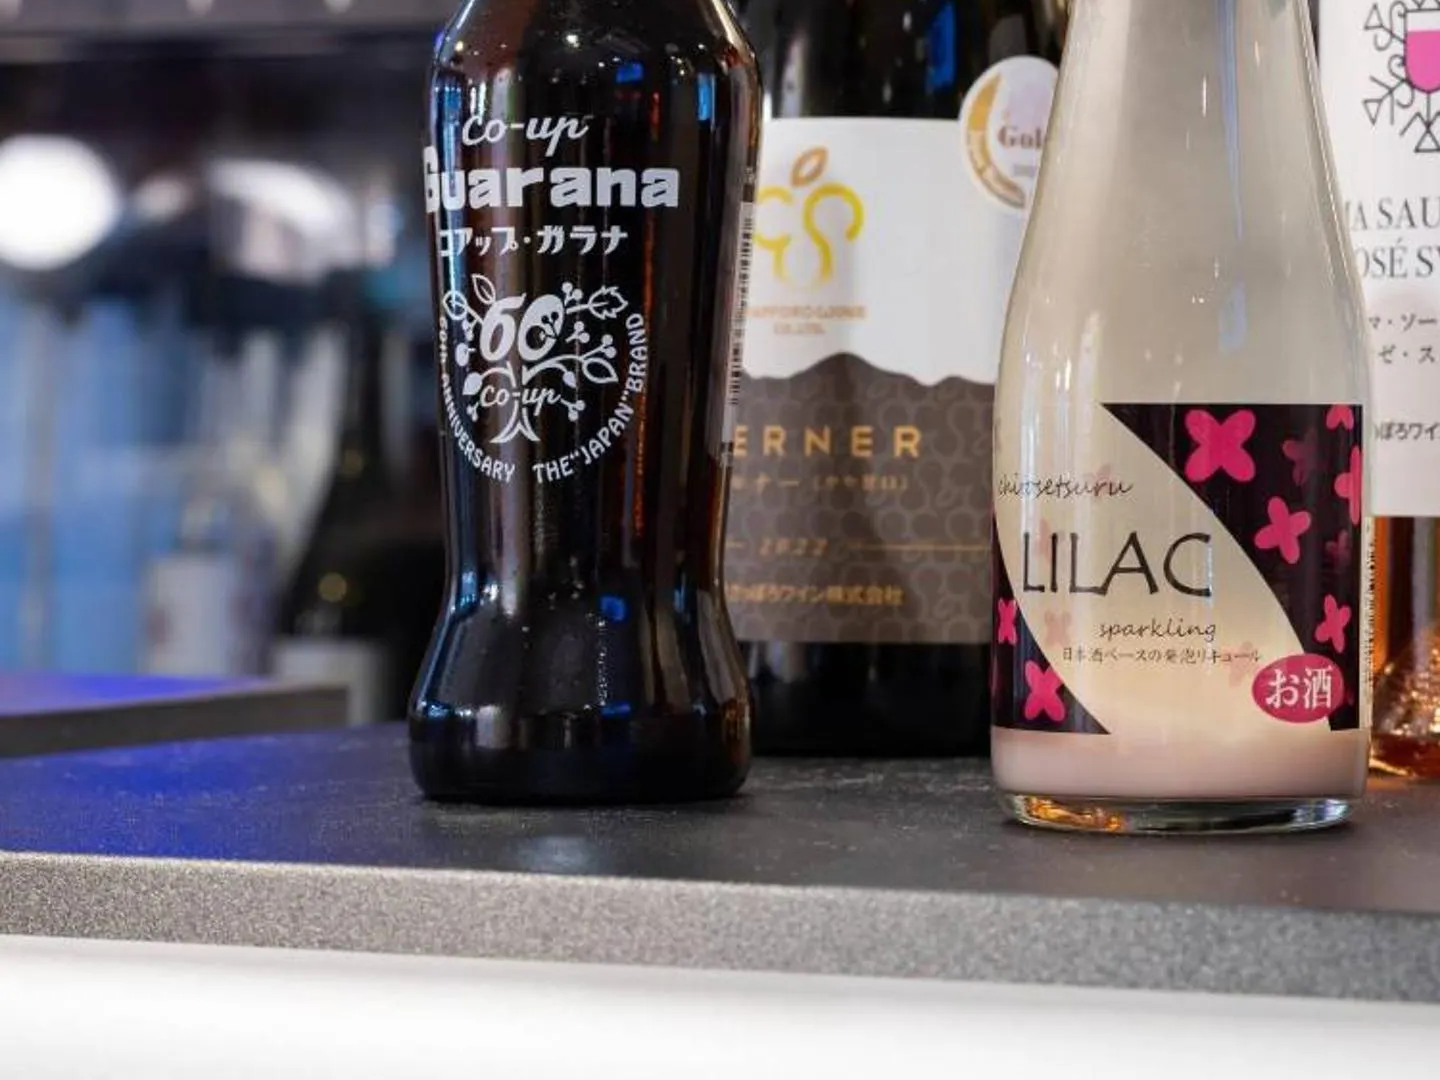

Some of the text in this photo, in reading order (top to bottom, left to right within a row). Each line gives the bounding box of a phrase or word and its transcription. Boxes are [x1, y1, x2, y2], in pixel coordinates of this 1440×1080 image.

[997, 125, 1046, 150] Gol
[424, 146, 679, 213] Guarana
[532, 456, 574, 484] THE
[625, 313, 649, 392] BRAND
[733, 425, 922, 458] ERNER
[1023, 531, 1212, 598] LILAC
[1099, 618, 1216, 643] sparkling
[1266, 666, 1333, 709] お酒
